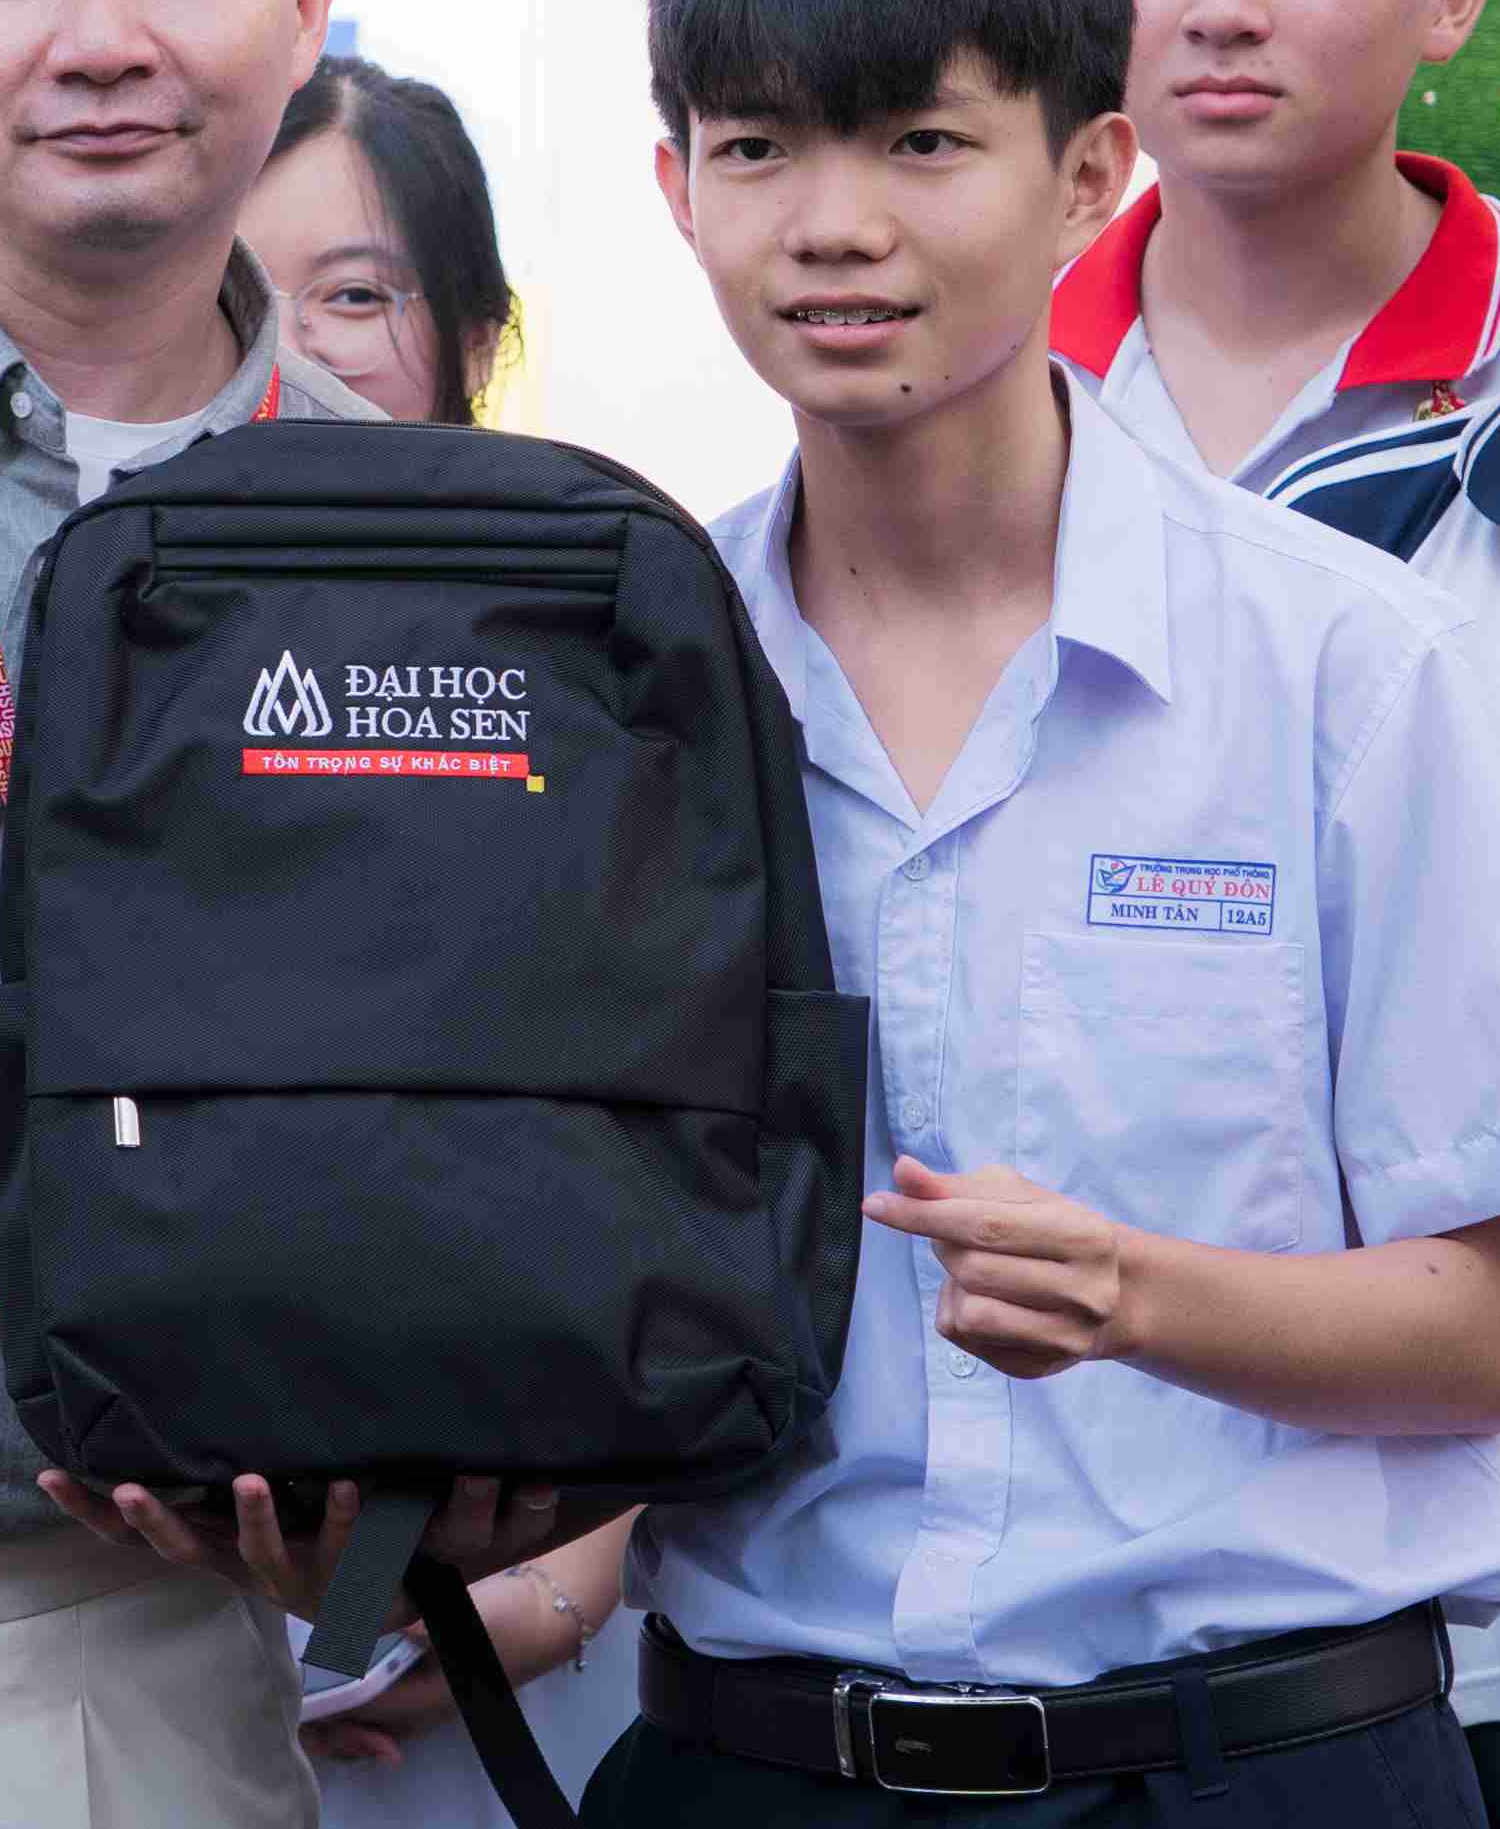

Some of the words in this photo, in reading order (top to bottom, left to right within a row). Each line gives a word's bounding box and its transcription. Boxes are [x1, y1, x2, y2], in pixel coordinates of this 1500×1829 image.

[345, 664, 422, 702] ĐẠI
[428, 666, 528, 705] HỌC
[345, 706, 444, 739] HOA
[449, 708, 531, 742] SEN
[262, 750, 300, 770] TÔN
[306, 755, 372, 775] TRỌNG
[379, 752, 405, 773] SỰ
[411, 751, 462, 772] KHÁC
[469, 754, 512, 774] BIỆT
[1136, 873, 1165, 894] LÊ
[1171, 875, 1217, 898] QUÝ
[1222, 878, 1272, 900] ĐÔN
[1110, 902, 1158, 921] MINH
[1226, 908, 1268, 927] 12A5
